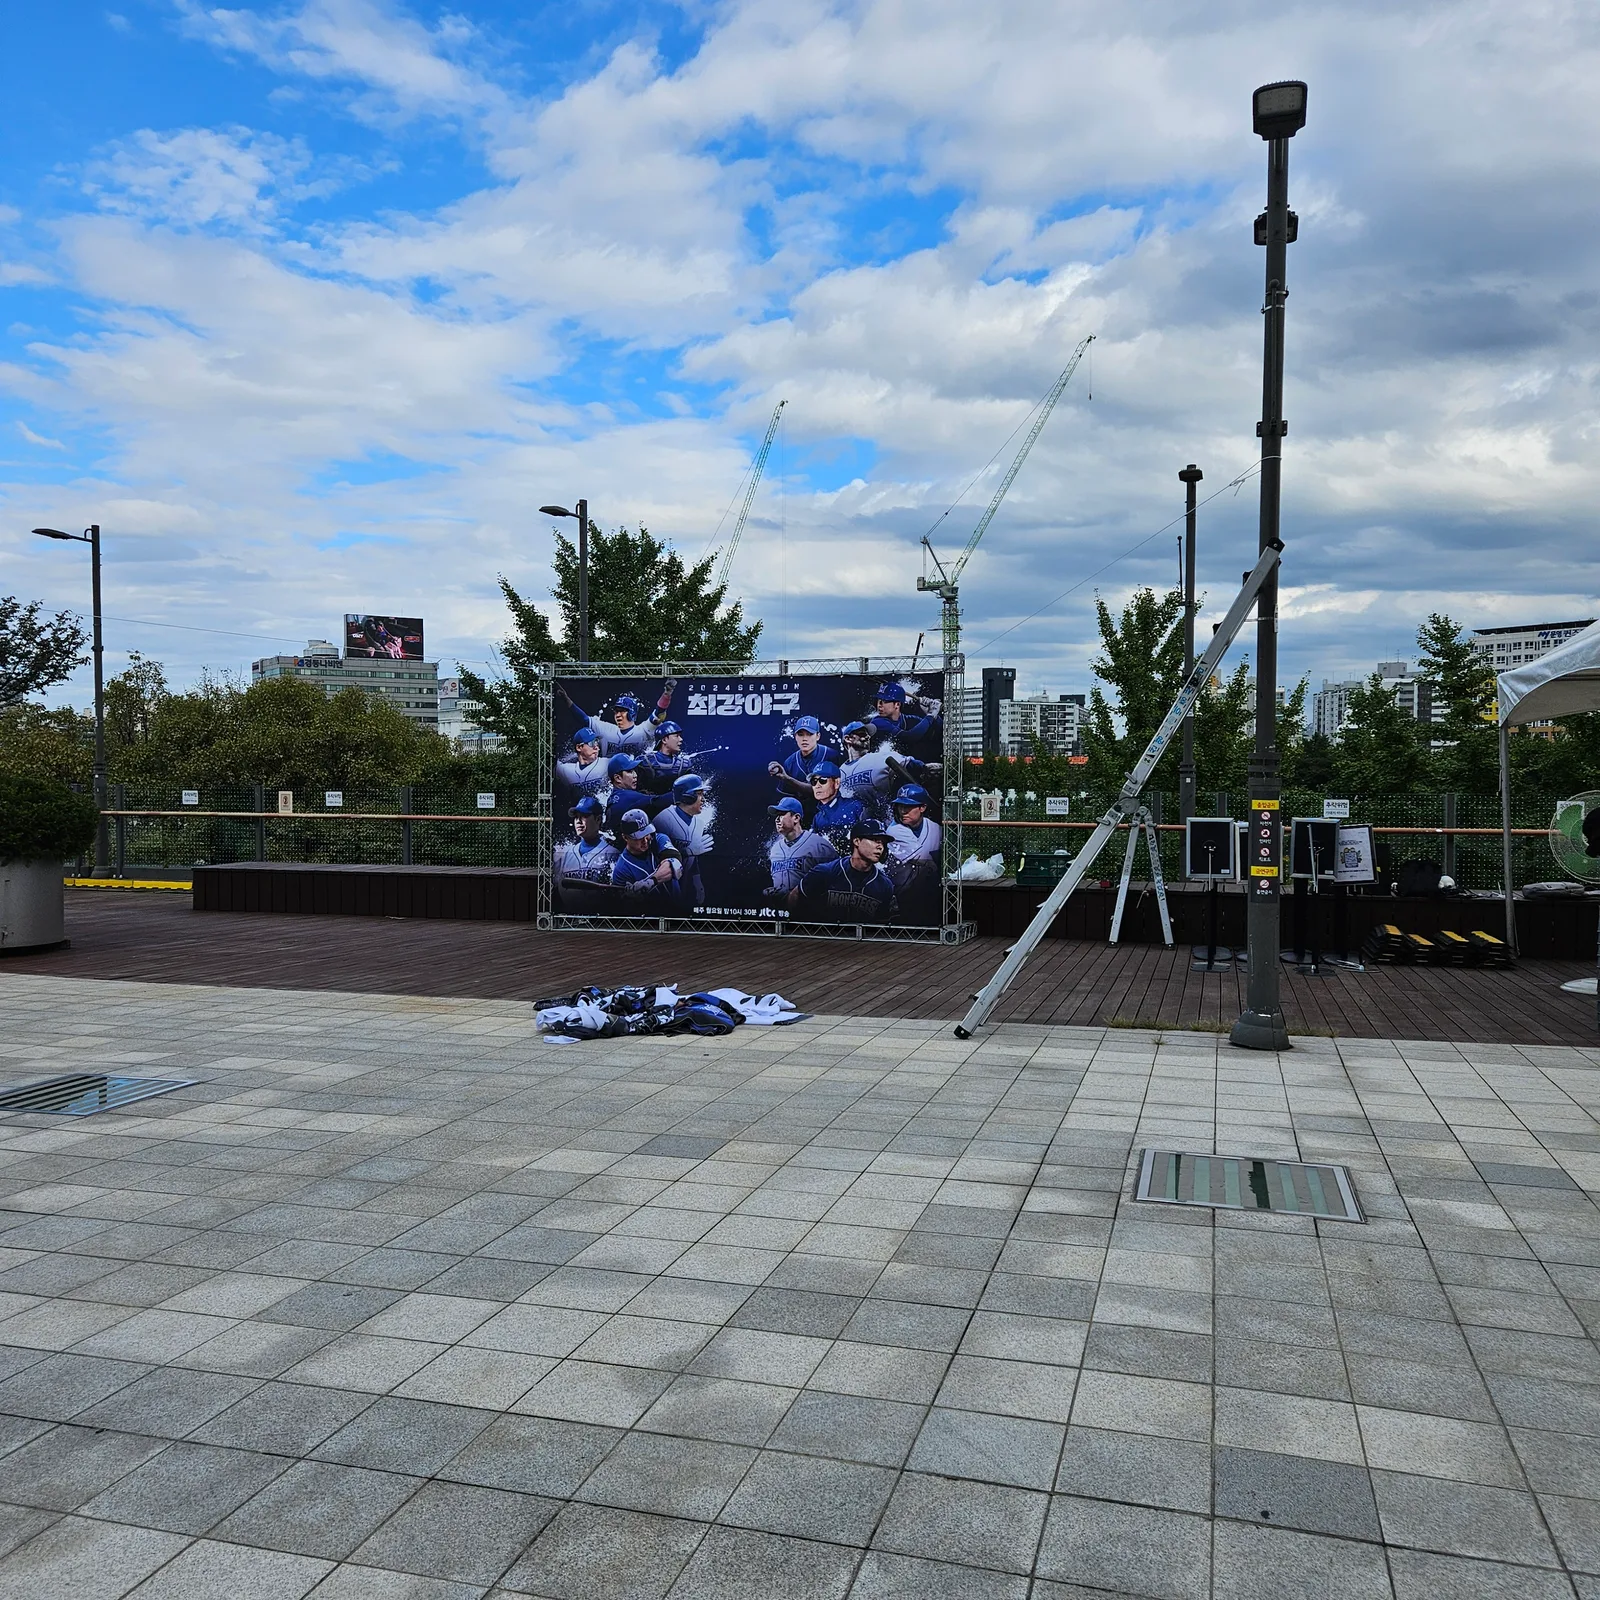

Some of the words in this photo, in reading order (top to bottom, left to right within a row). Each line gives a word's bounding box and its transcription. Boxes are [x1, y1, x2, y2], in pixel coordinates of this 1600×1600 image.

[688, 684, 731, 692] 2024
[737, 683, 800, 691] SEASON
[687, 693, 800, 716] 최강야구
[706, 907, 723, 915] 월요일
